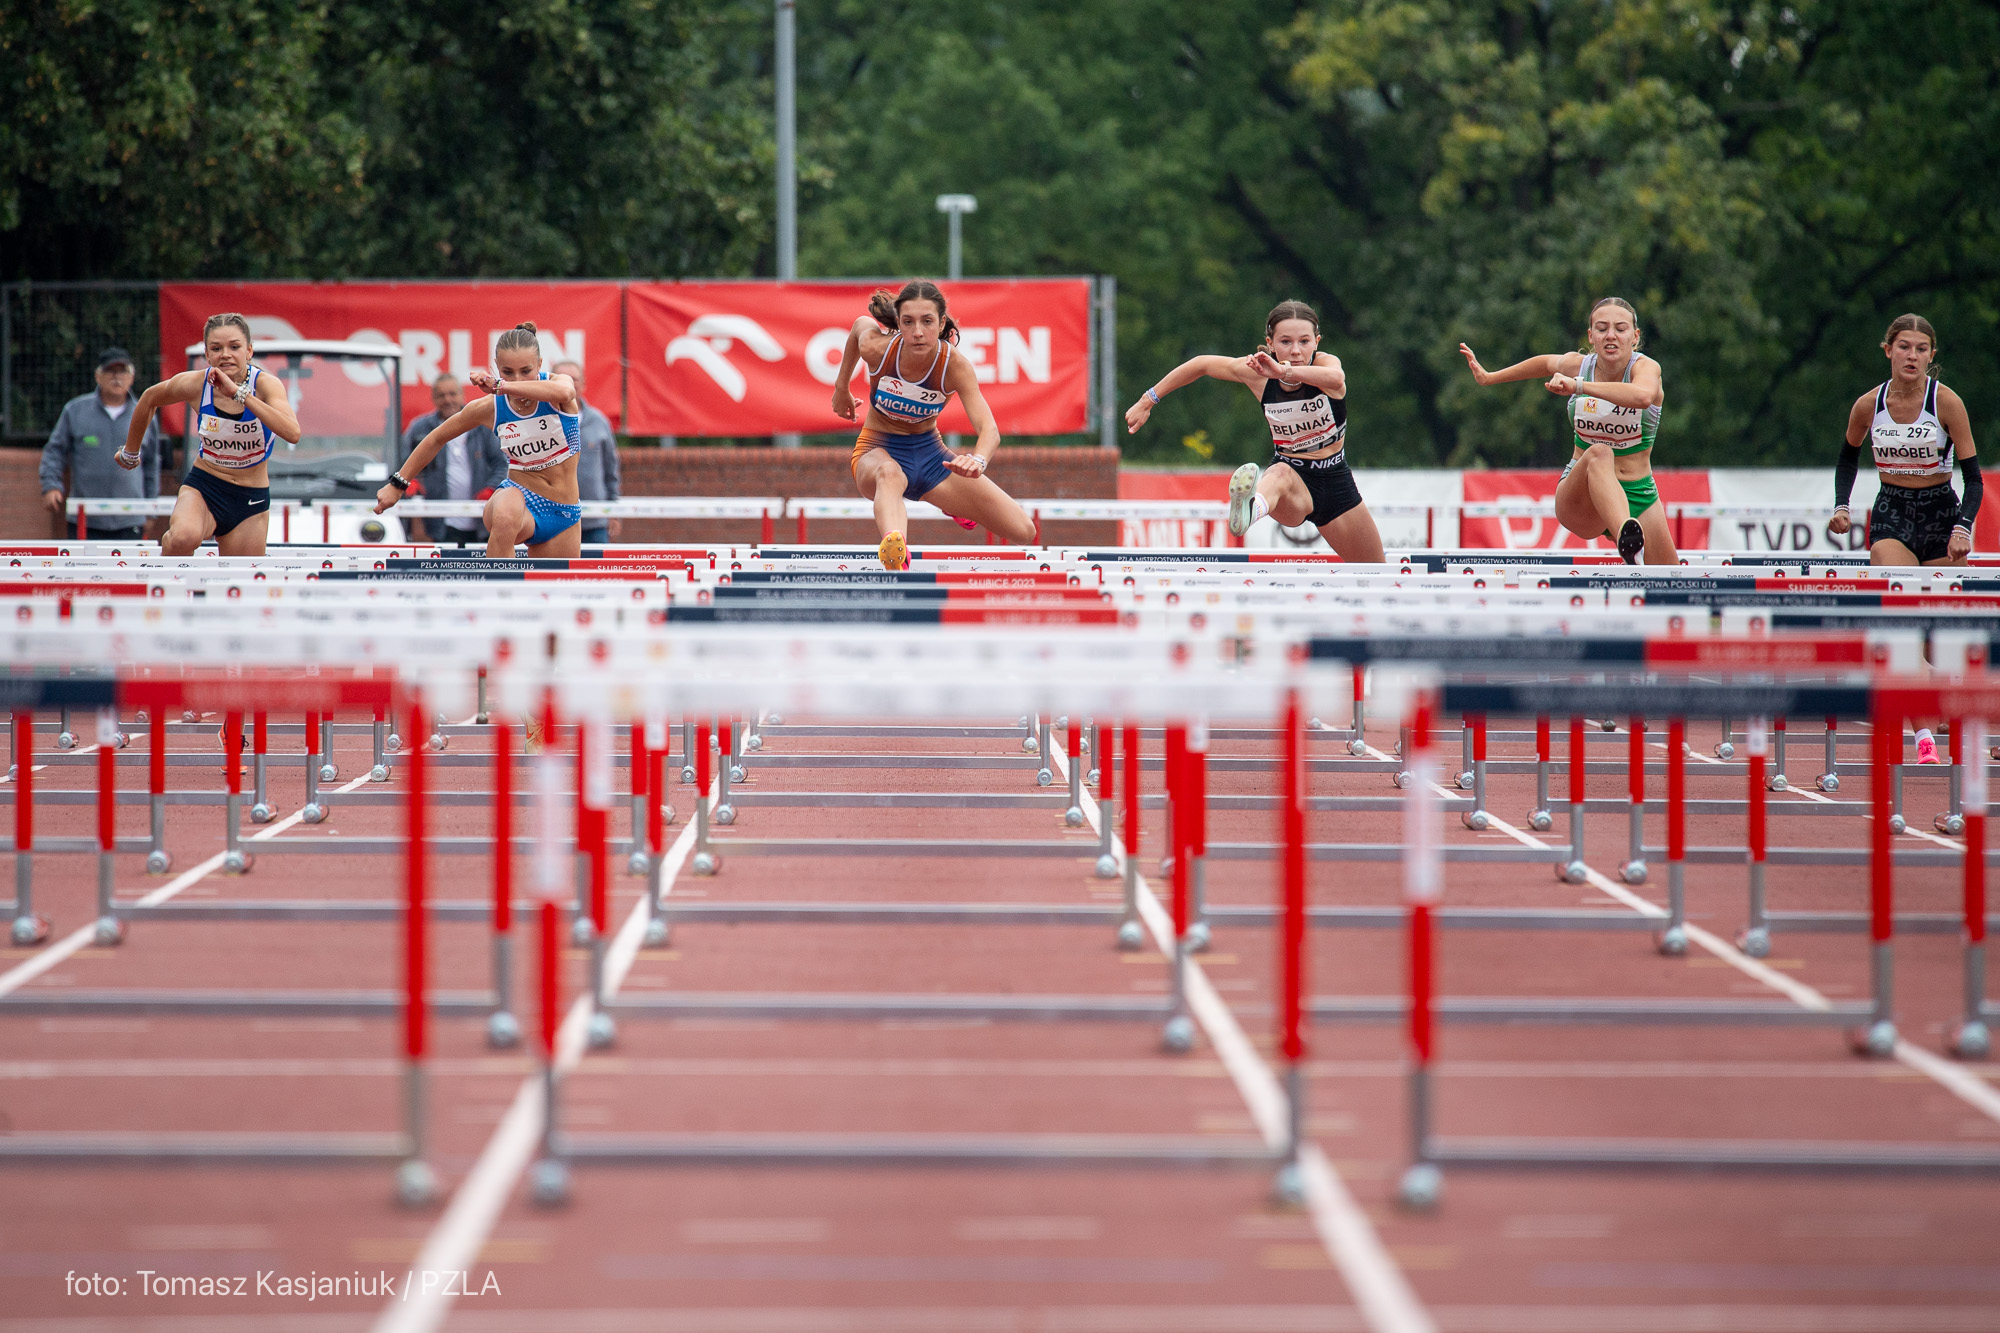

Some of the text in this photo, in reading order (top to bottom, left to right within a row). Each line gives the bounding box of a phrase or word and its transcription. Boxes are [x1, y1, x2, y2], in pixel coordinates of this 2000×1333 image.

[343, 328, 585, 387] ORLN
[805, 326, 1051, 384] OEN
[920, 391, 938, 402] 29
[1301, 398, 1324, 413] 430
[234, 422, 258, 433] 505
[539, 419, 548, 430] 3
[1273, 414, 1331, 436] BELNIAK
[1577, 419, 1638, 434] DRAGOW
[1880, 429, 1900, 437] FUEL
[1907, 427, 1930, 438] 297
[203, 437, 261, 450] DOMNIK
[507, 437, 559, 457] KICUŁA
[1876, 445, 1934, 458] WRÓBEL
[1881, 485, 1950, 498] NIKE PRO
[1011, 579, 1036, 588] 2023
[1788, 584, 1856, 593] SŁUBICE 2023
